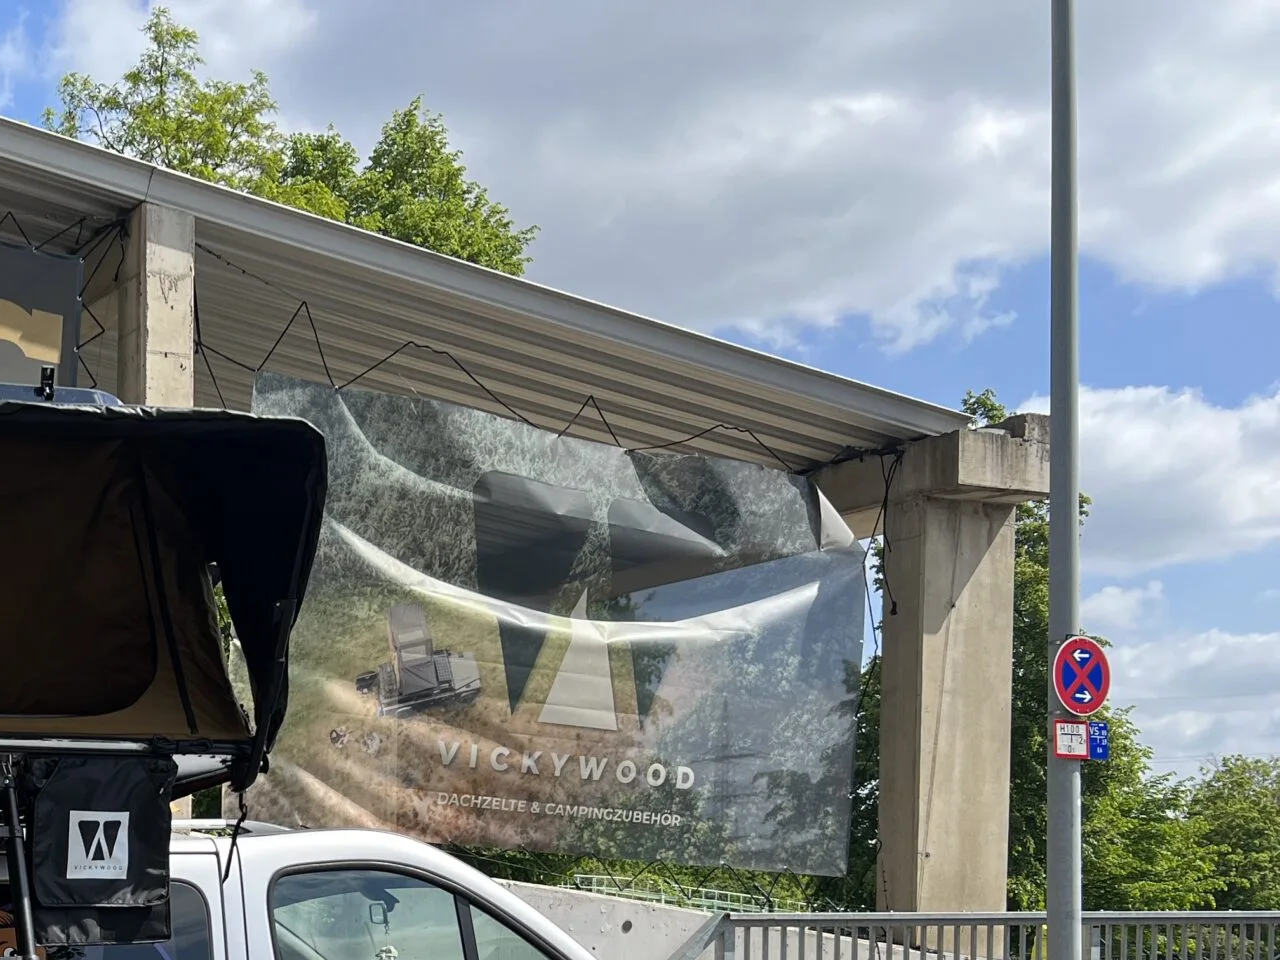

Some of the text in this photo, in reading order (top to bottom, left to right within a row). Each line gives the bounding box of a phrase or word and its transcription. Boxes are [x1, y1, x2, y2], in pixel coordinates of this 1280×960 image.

[437, 741, 696, 790] VICKYWOOD
[437, 792, 682, 827] DACHZELTE & CAMPINGZUBEHÖR
